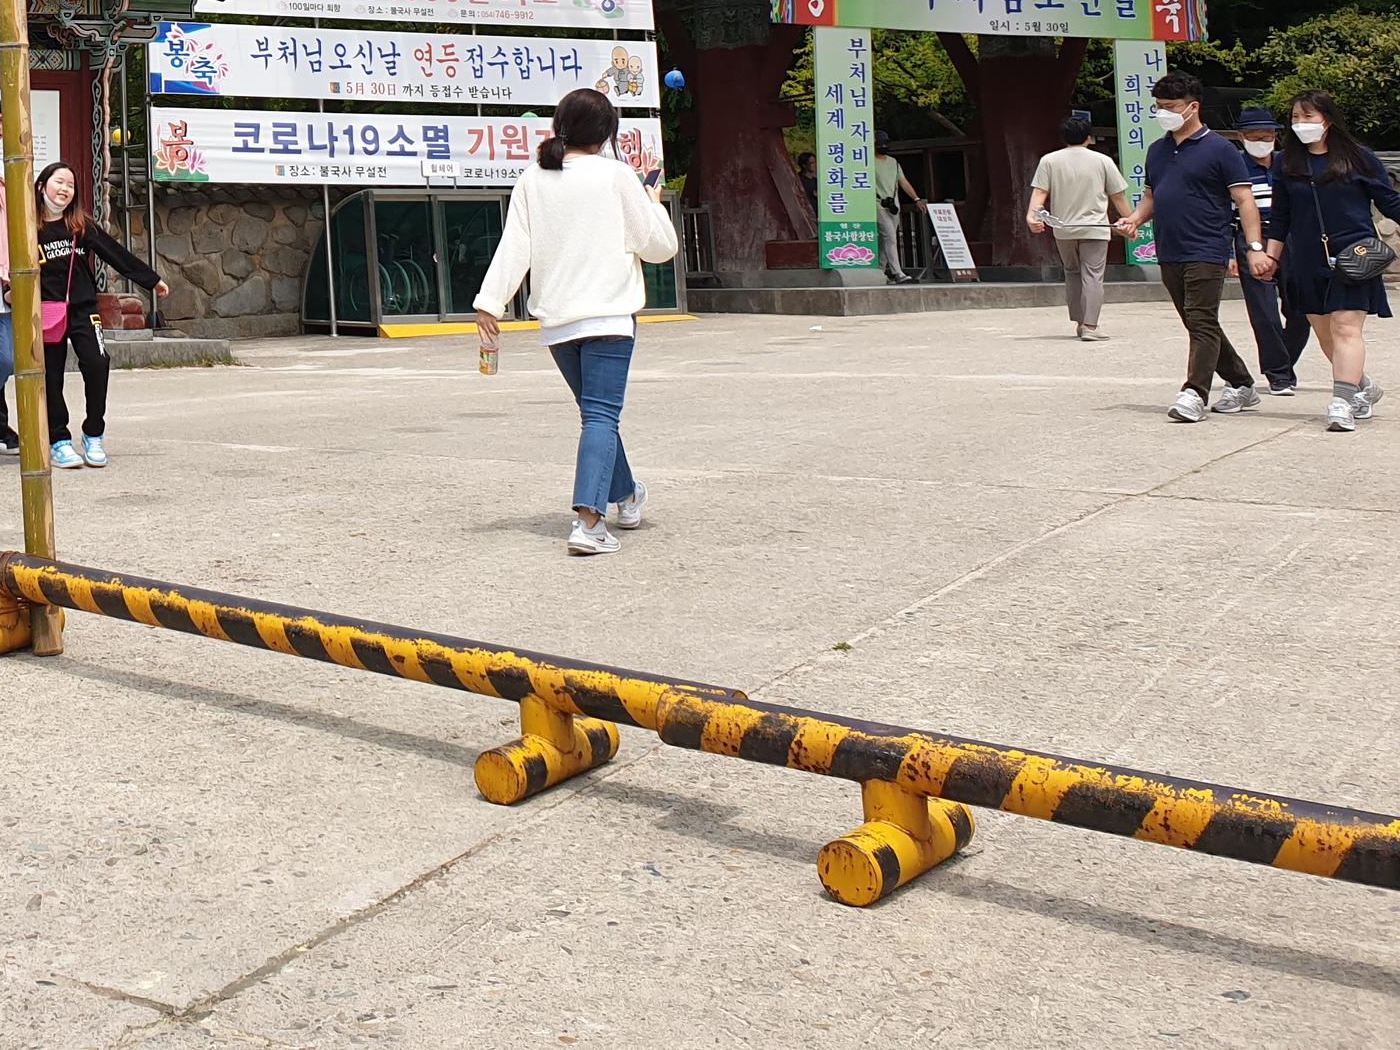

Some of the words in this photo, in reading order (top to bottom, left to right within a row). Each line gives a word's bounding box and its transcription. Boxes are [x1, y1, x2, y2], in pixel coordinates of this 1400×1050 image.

[288, 2, 324, 12] 100일마다
[390, 5, 411, 16] 불국사
[413, 6, 434, 17] 무설전
[990, 20, 1010, 31] 일시
[1024, 21, 1041, 32] 5월
[1046, 22, 1069, 33] 30일
[346, 82, 364, 95] 5月
[371, 82, 397, 96] 30日
[402, 84, 424, 97] 까지
[429, 84, 464, 98] 등접수
[468, 86, 512, 100] 받습니다
[847, 38, 867, 108] 부처님
[824, 83, 845, 130] 세계
[1124, 74, 1144, 150] 희망의
[160, 119, 194, 162] 봉
[231, 120, 451, 160] 코로나19소멸
[618, 126, 642, 169] 행
[850, 121, 872, 189] 자비로
[320, 165, 351, 178] 불국사
[355, 166, 387, 179] 무설전
[827, 142, 848, 214] 평화를
